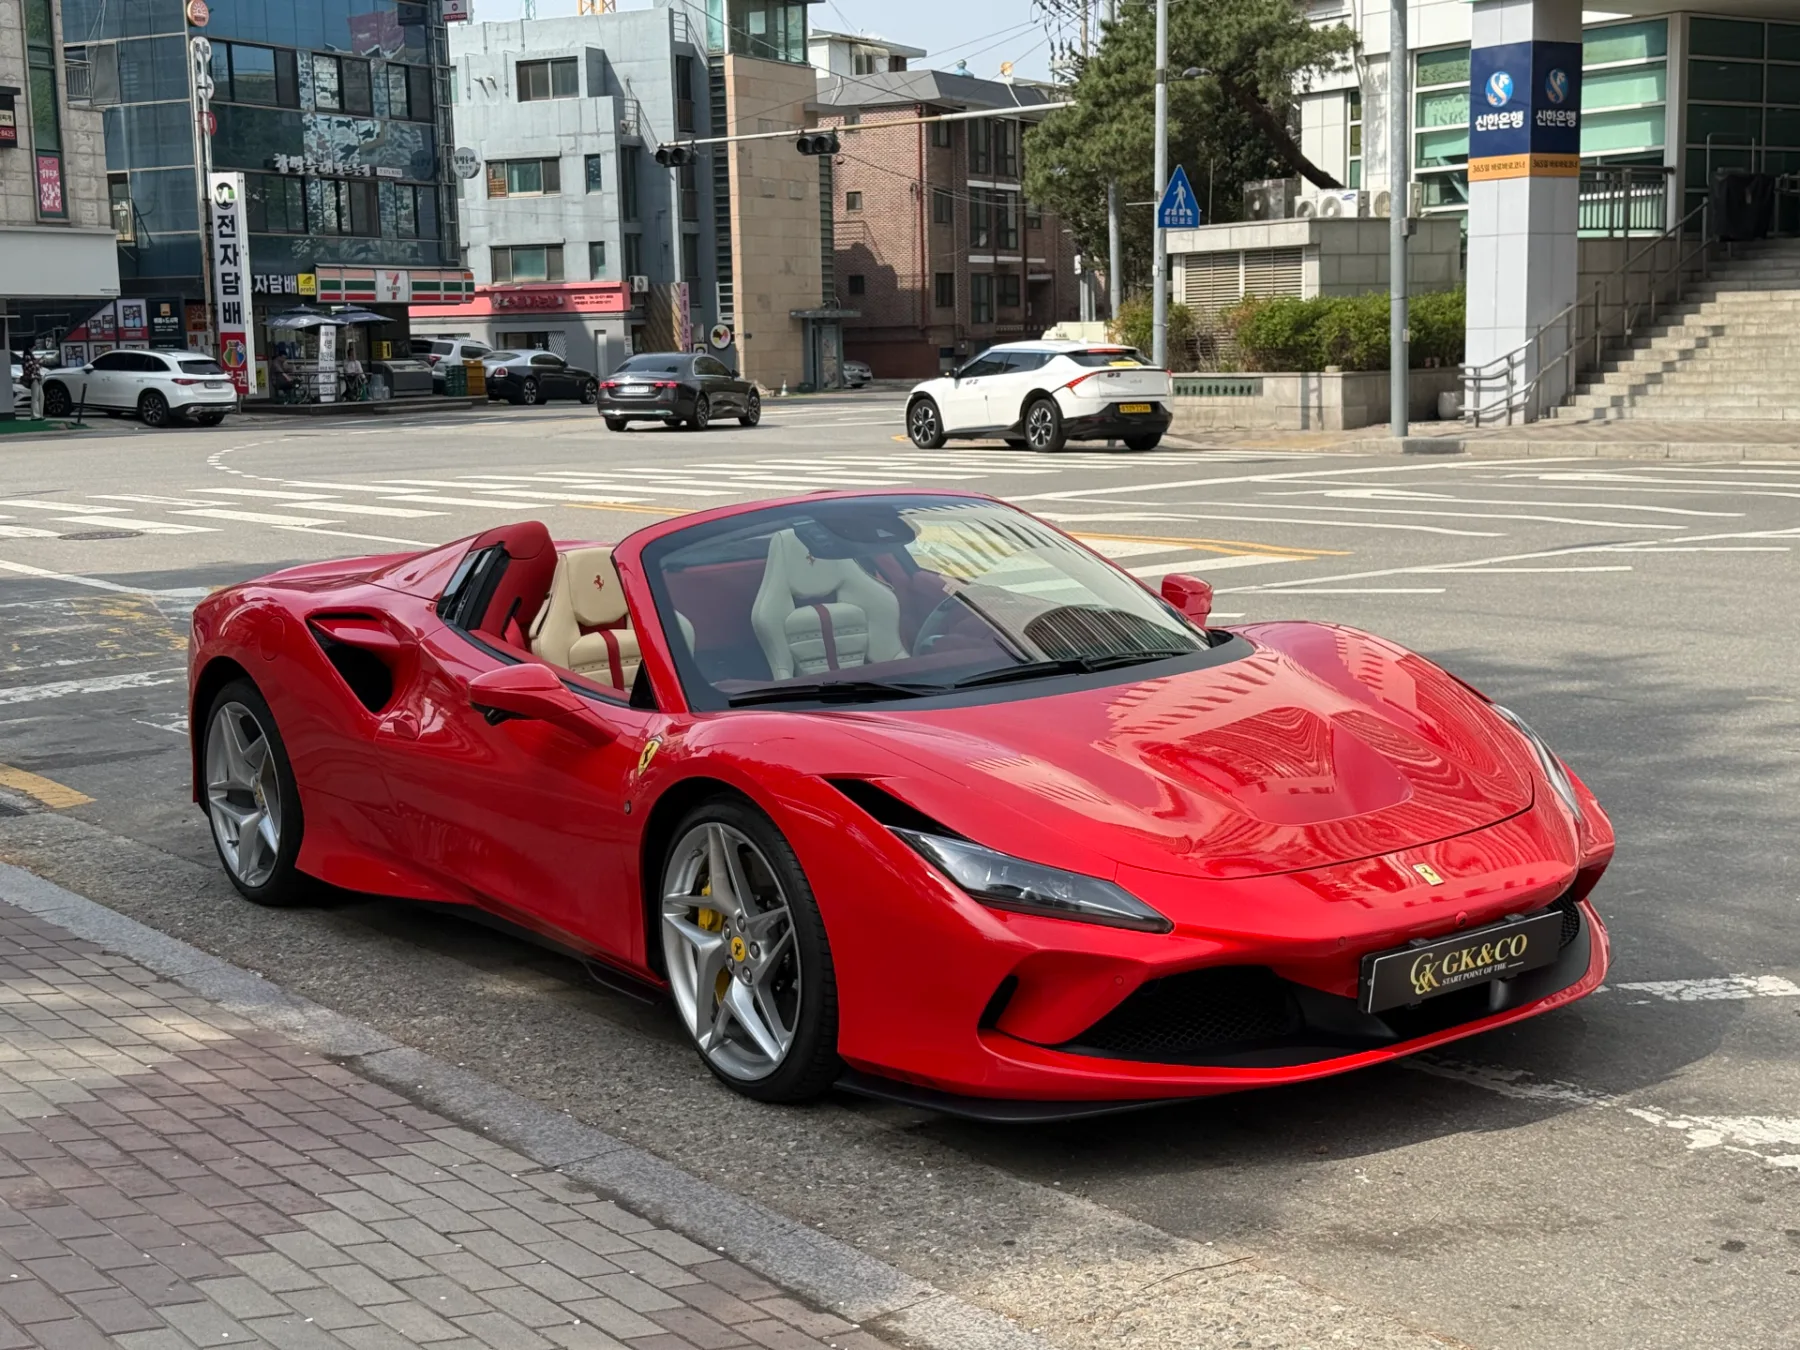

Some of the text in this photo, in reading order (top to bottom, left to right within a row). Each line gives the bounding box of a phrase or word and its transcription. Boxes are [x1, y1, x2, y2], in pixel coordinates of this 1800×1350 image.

[1475, 110, 1524, 131] 신한은행
[1535, 109, 1577, 128] 신한은행
[217, 214, 242, 325] 전자담배
[250, 274, 298, 294] 자담배
[1442, 933, 1528, 975] GK&CO
[1442, 961, 1508, 987] START POINT OF THE
